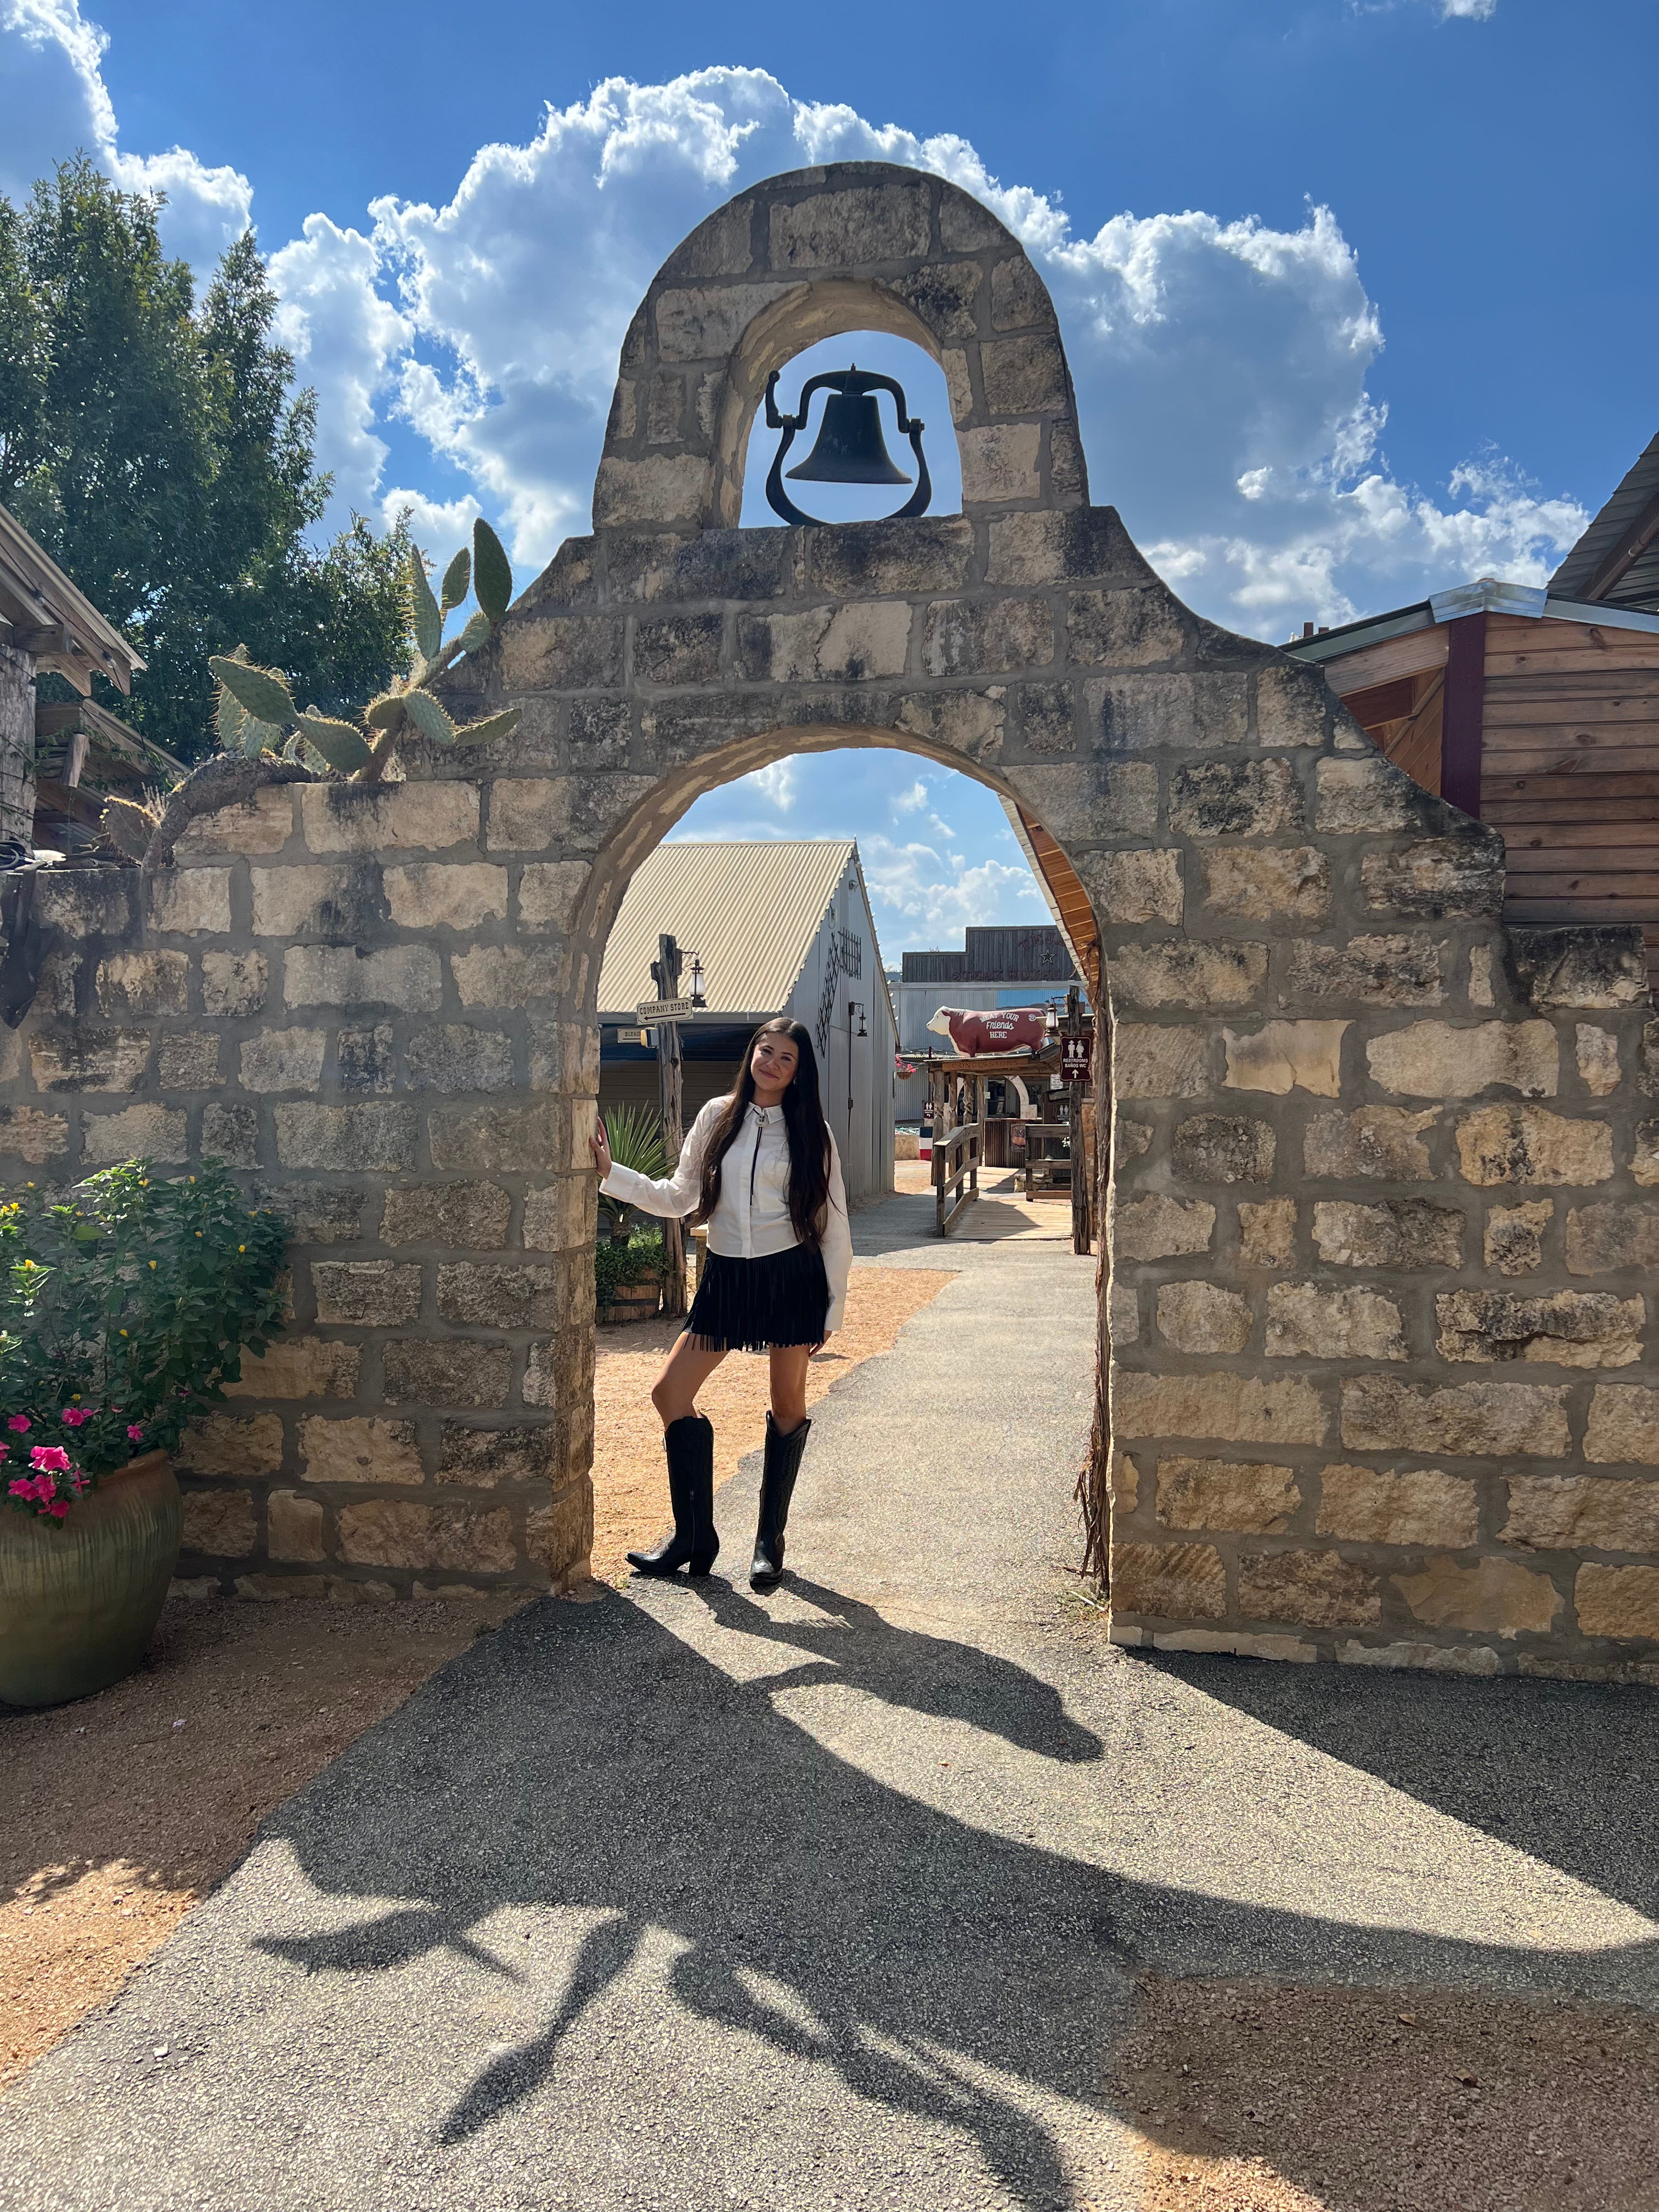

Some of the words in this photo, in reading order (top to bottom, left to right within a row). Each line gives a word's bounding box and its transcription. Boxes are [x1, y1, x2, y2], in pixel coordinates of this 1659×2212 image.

[953, 969, 1003, 980] STEAK
[1008, 969, 1061, 980] HOUSE
[640, 1004, 669, 1015] COMPANY
[670, 1002, 689, 1011] STORE
[979, 1013, 998, 1023] MEAT
[1001, 1012, 1019, 1022] YOUR
[986, 1021, 1014, 1030] Friends
[952, 1059, 1018, 1069] CONCESSIONS
